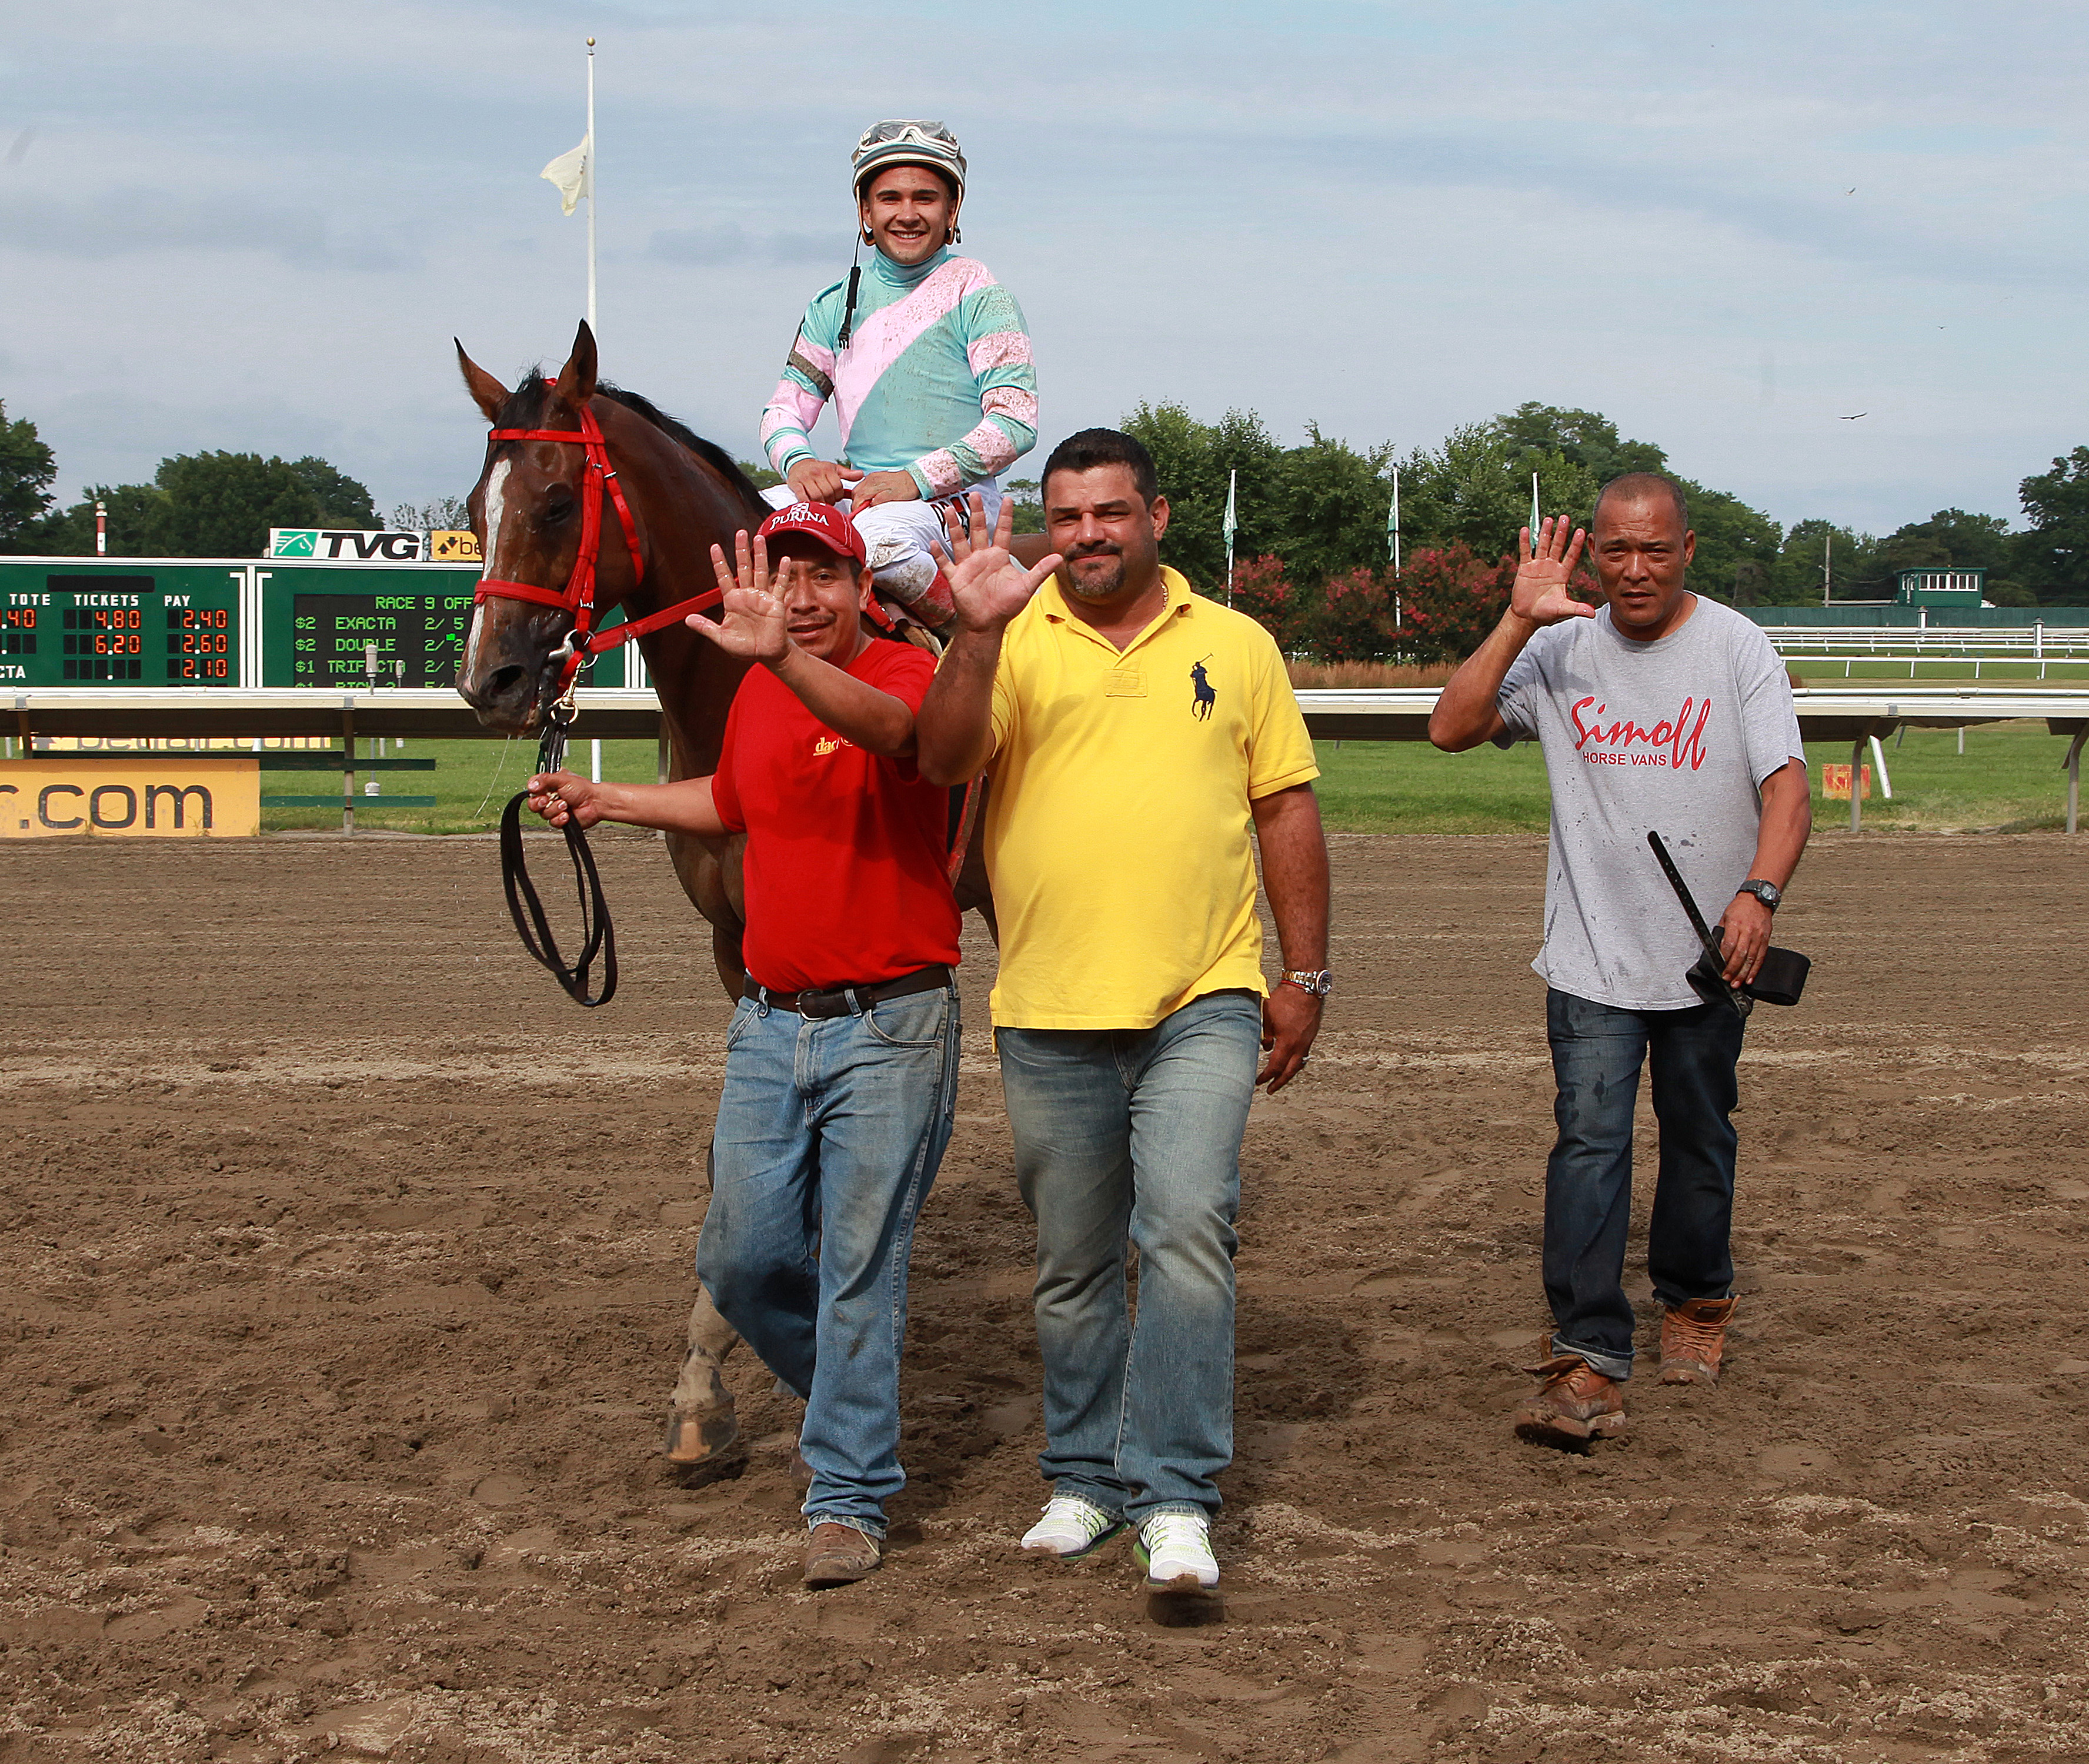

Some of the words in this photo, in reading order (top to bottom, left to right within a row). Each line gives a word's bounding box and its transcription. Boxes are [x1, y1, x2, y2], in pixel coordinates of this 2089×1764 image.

[770, 512, 829, 530] PURINA
[322, 532, 420, 559] TVG
[9, 593, 51, 606] TOTE
[74, 594, 139, 606] TICKETS
[164, 595, 191, 607] PAY
[375, 596, 416, 610] RACE
[424, 597, 435, 610] 9
[444, 597, 473, 610] OFF
[0, 609, 36, 629] .40
[95, 610, 141, 630] 4.80
[183, 610, 228, 630] 2.40
[295, 616, 316, 629] $2
[335, 617, 396, 630] EXACTA
[95, 634, 141, 655] 6.20
[183, 634, 228, 654] 2.60
[295, 638, 316, 651] $2
[183, 659, 228, 679] 2.10
[295, 660, 315, 673] $1
[327, 660, 406, 673] TRIFCT
[1583, 751, 1626, 766] HORSE
[1631, 754, 1667, 766] VANS
